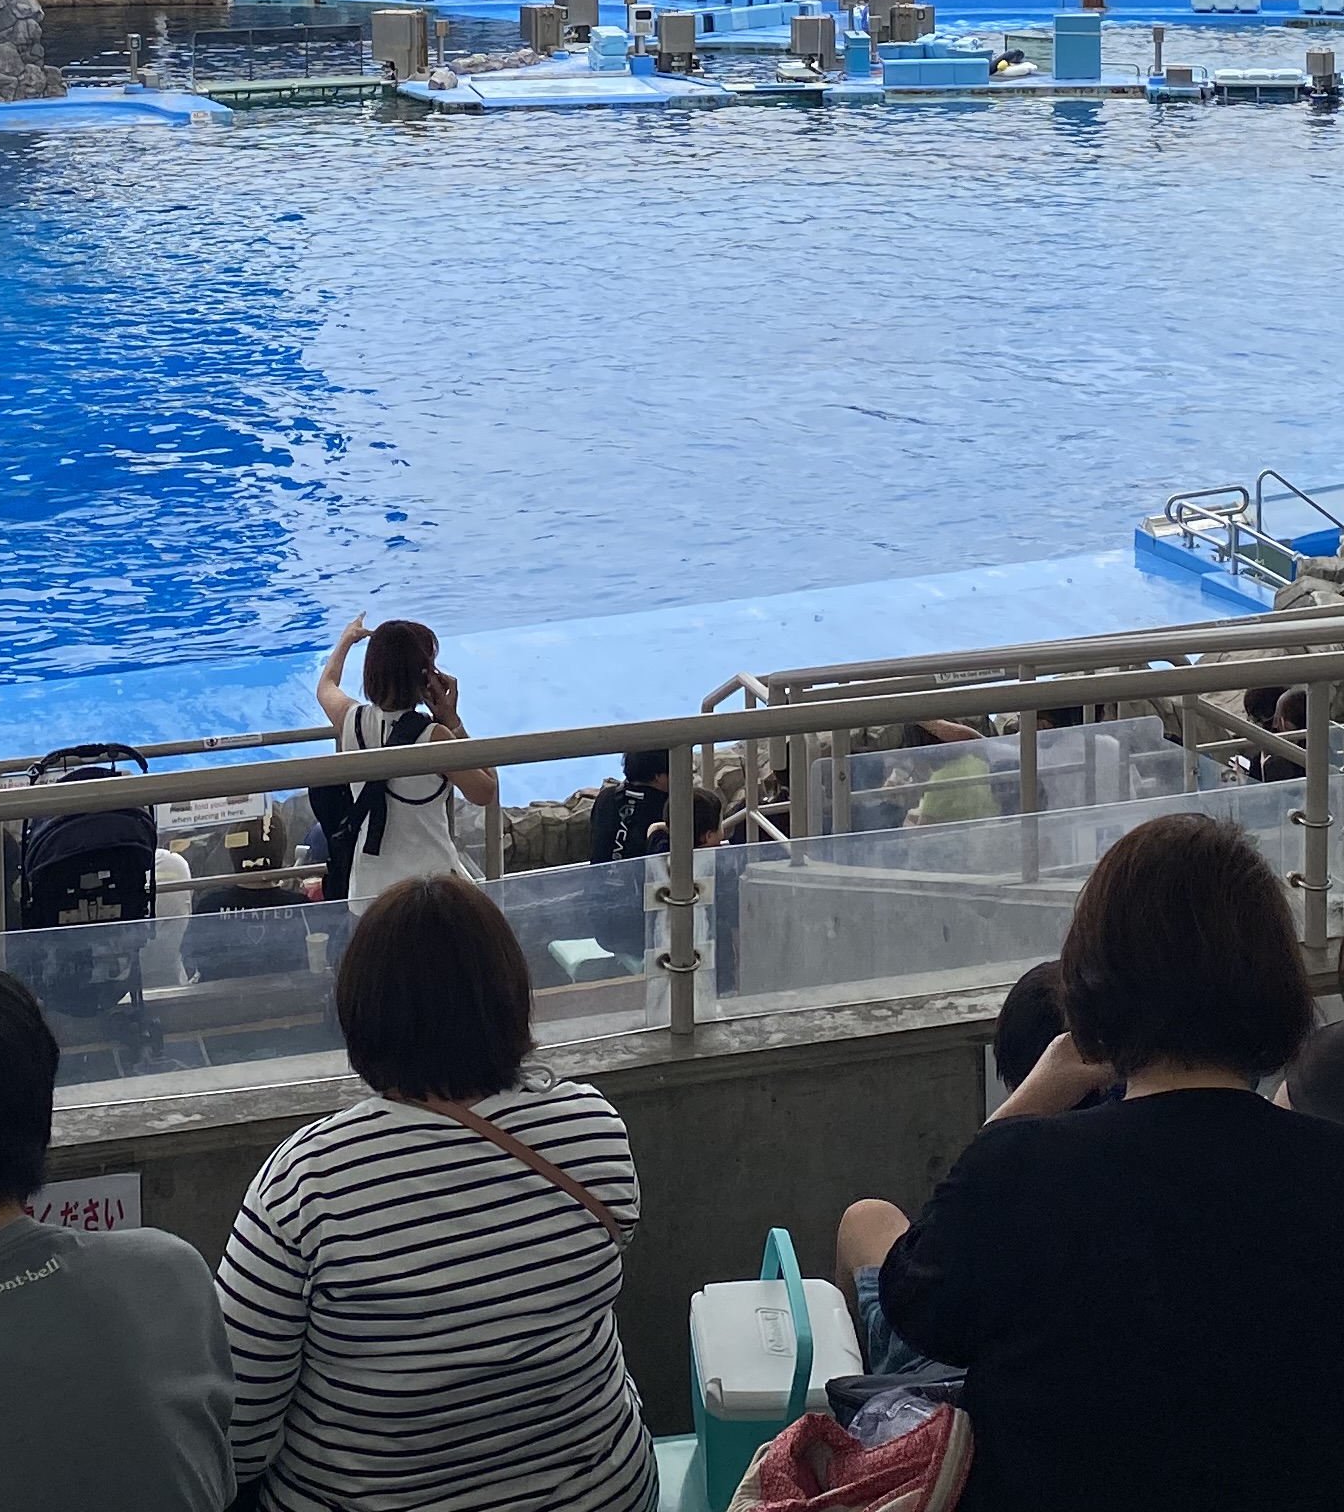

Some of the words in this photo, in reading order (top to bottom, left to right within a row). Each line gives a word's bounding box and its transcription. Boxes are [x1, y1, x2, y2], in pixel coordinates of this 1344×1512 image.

[171, 816, 192, 824] when
[22, 1198, 124, 1231] ください
